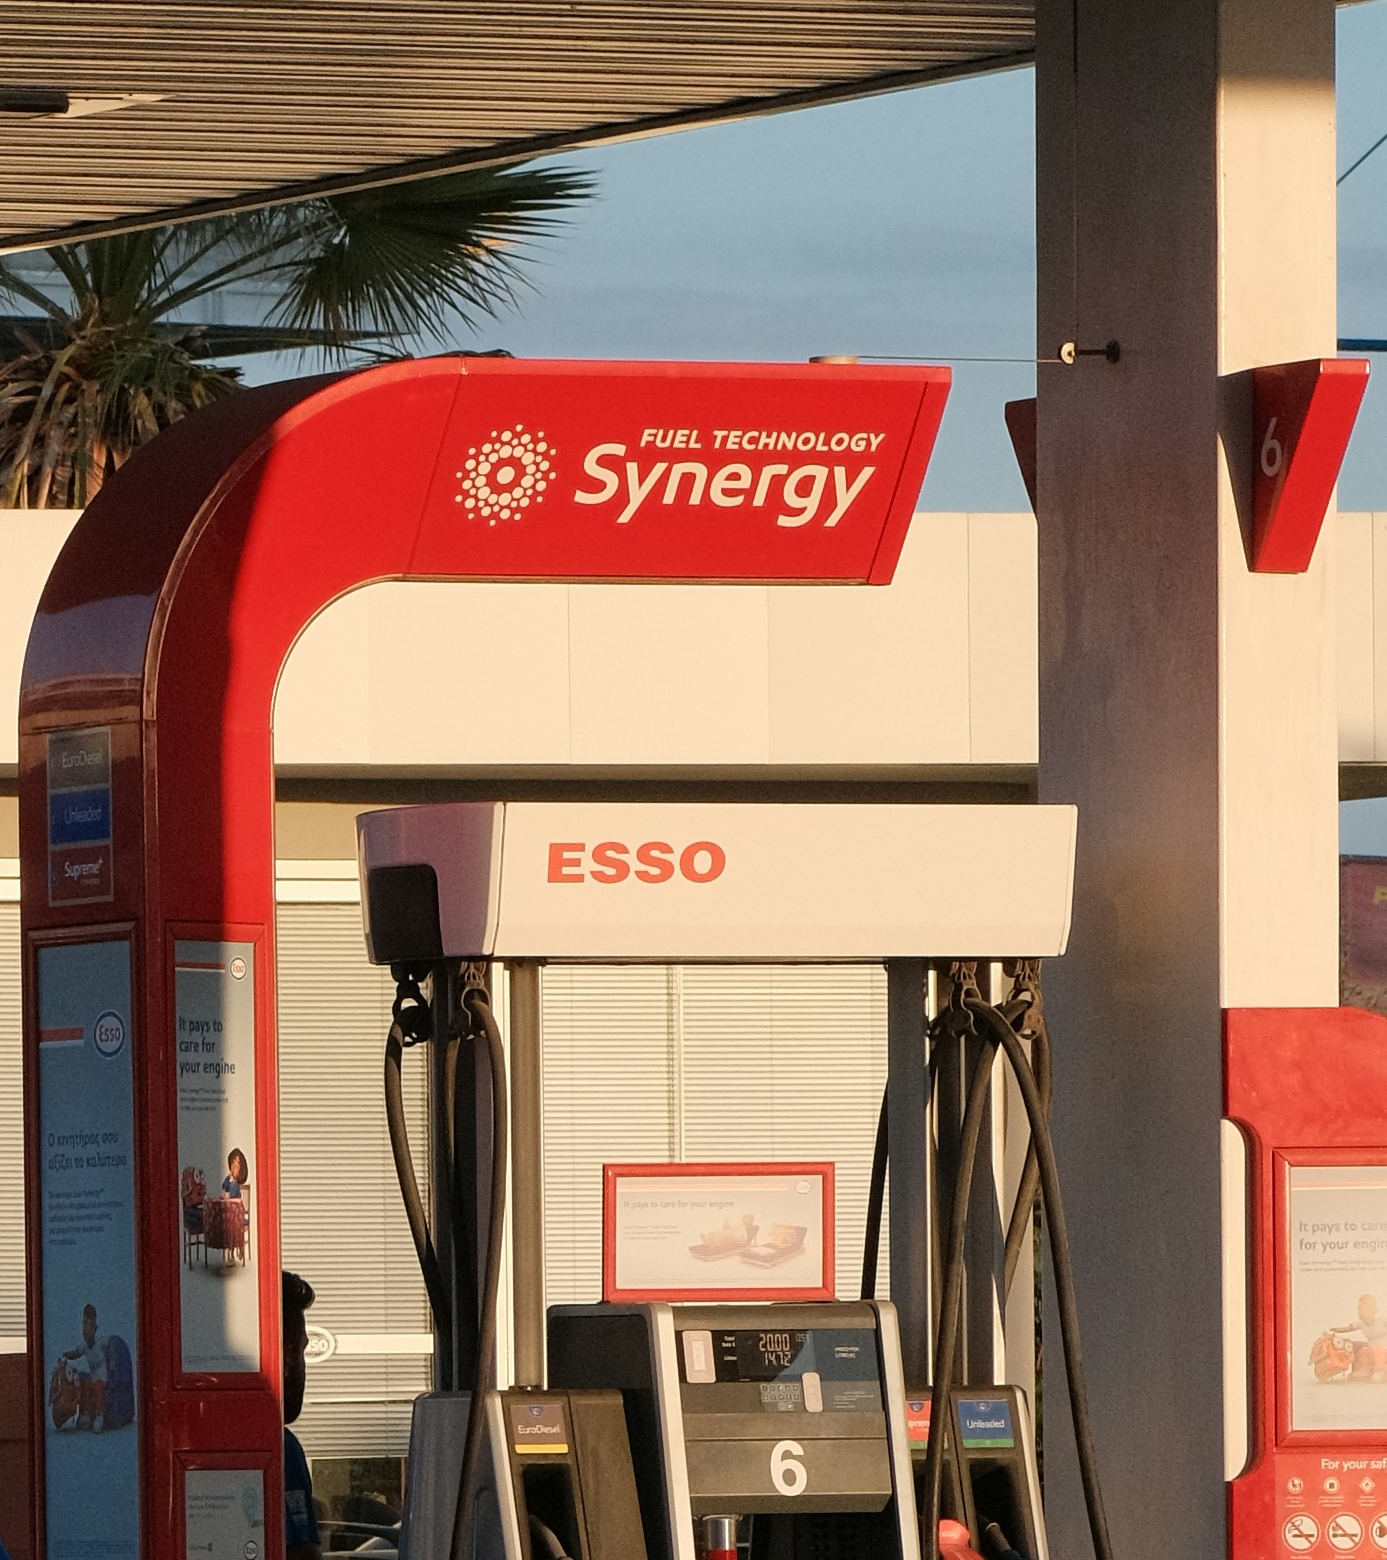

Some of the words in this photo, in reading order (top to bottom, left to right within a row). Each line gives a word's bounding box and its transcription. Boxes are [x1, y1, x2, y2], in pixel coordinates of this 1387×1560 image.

[640, 429, 702, 449] FUEL
[713, 430, 885, 452] TECHNOLOGY
[1261, 417, 1282, 476] 6
[574, 443, 876, 528] Synergy
[64, 804, 102, 825] Unleaded
[547, 841, 726, 884] ESSO
[98, 1024, 121, 1042] Esso
[179, 1016, 186, 1031] It
[189, 1020, 210, 1036] pays
[213, 1019, 223, 1032] to
[179, 1042, 199, 1053] care
[202, 1037, 216, 1053] for
[179, 1061, 201, 1077] your
[203, 1057, 236, 1079] engine
[1299, 1221, 1308, 1233] It
[1312, 1223, 1341, 1236] pays
[1344, 1221, 1357, 1232] to
[1299, 1238, 1319, 1251] for
[1321, 1240, 1351, 1254] your
[1353, 1237, 1387, 1253] engin
[517, 1424, 561, 1434] EuroDiesel
[966, 1419, 1005, 1429] Unleaded
[770, 1440, 808, 1497] 6
[1321, 1458, 1339, 1469] For
[1342, 1460, 1368, 1472] your
